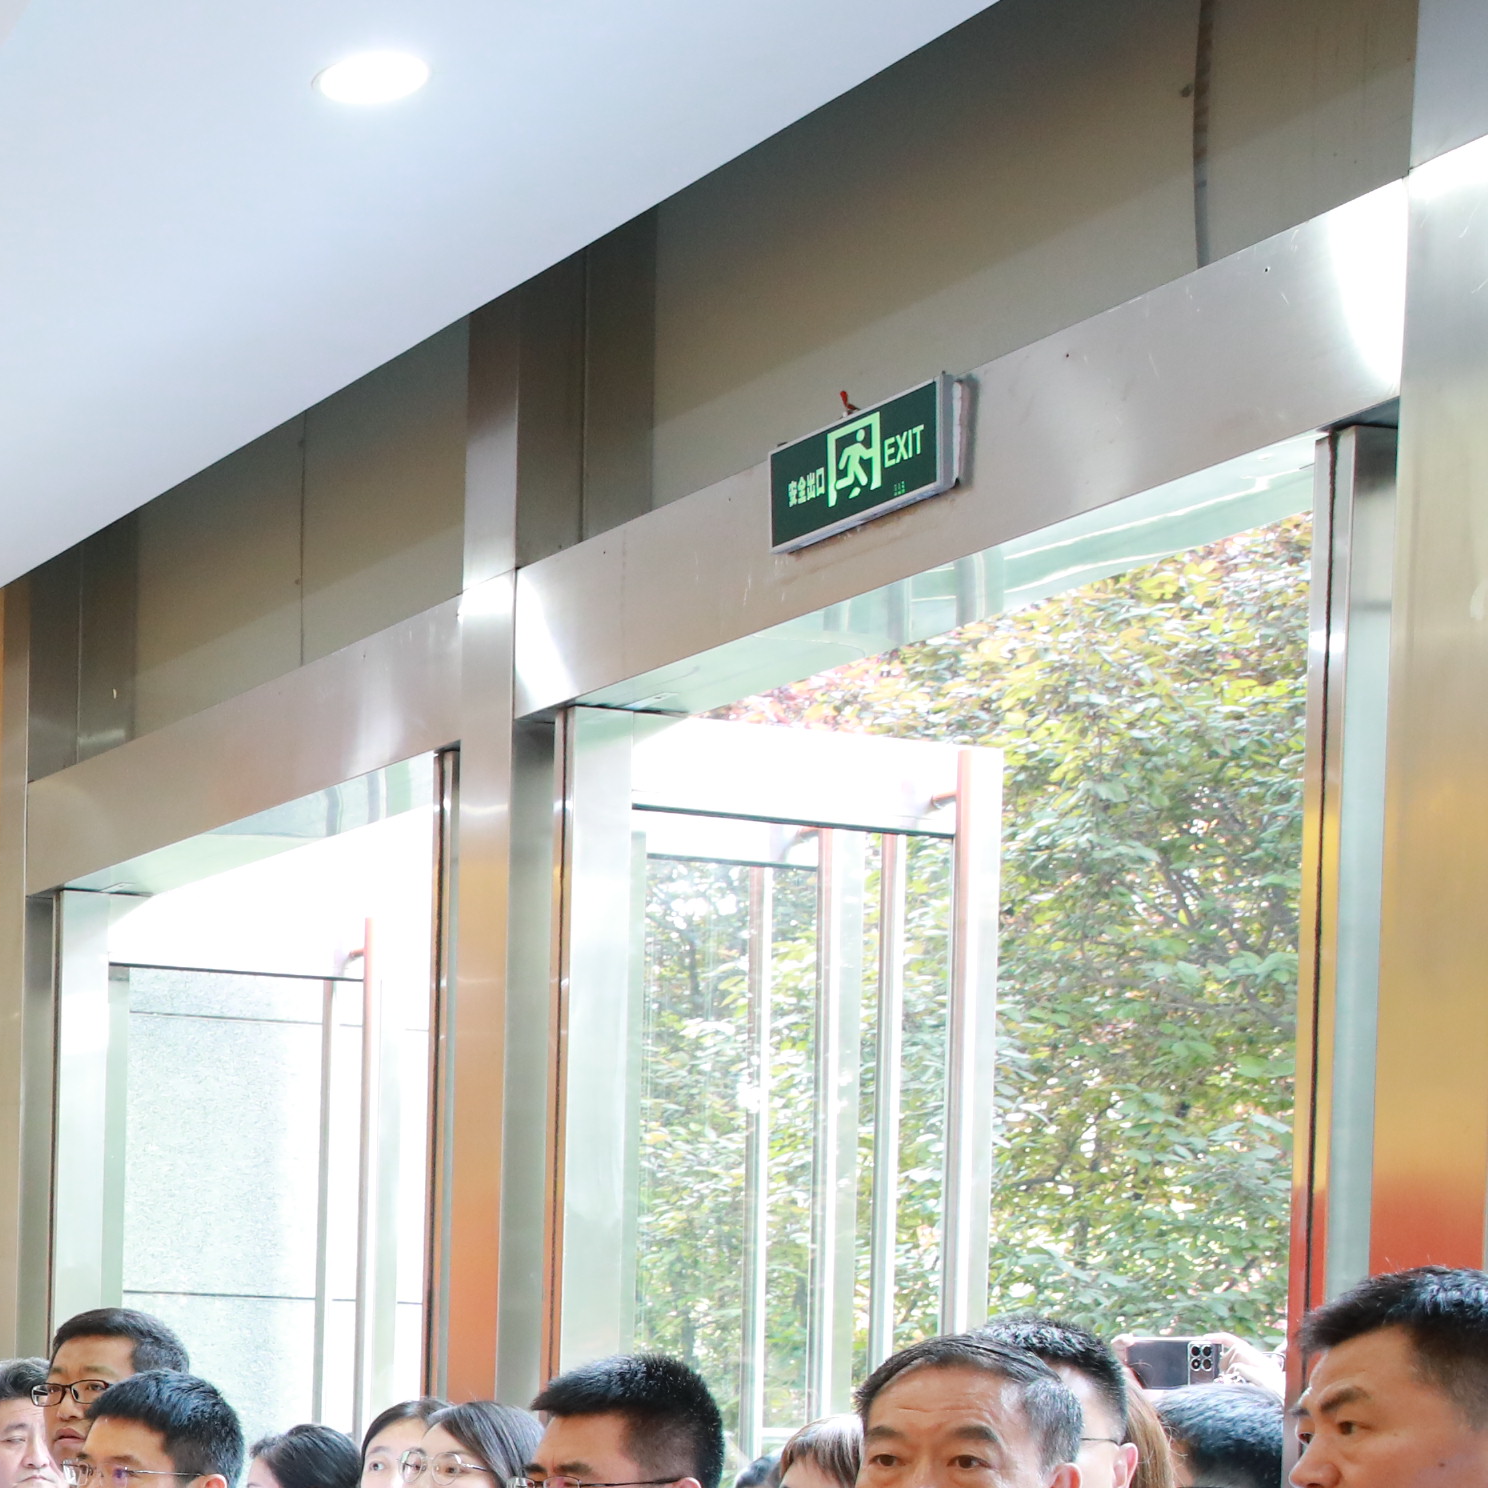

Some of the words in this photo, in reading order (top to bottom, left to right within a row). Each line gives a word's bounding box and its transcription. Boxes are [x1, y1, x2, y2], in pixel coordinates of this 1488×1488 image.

[884, 424, 925, 468] EXIT
[787, 466, 826, 508] 安全出口
